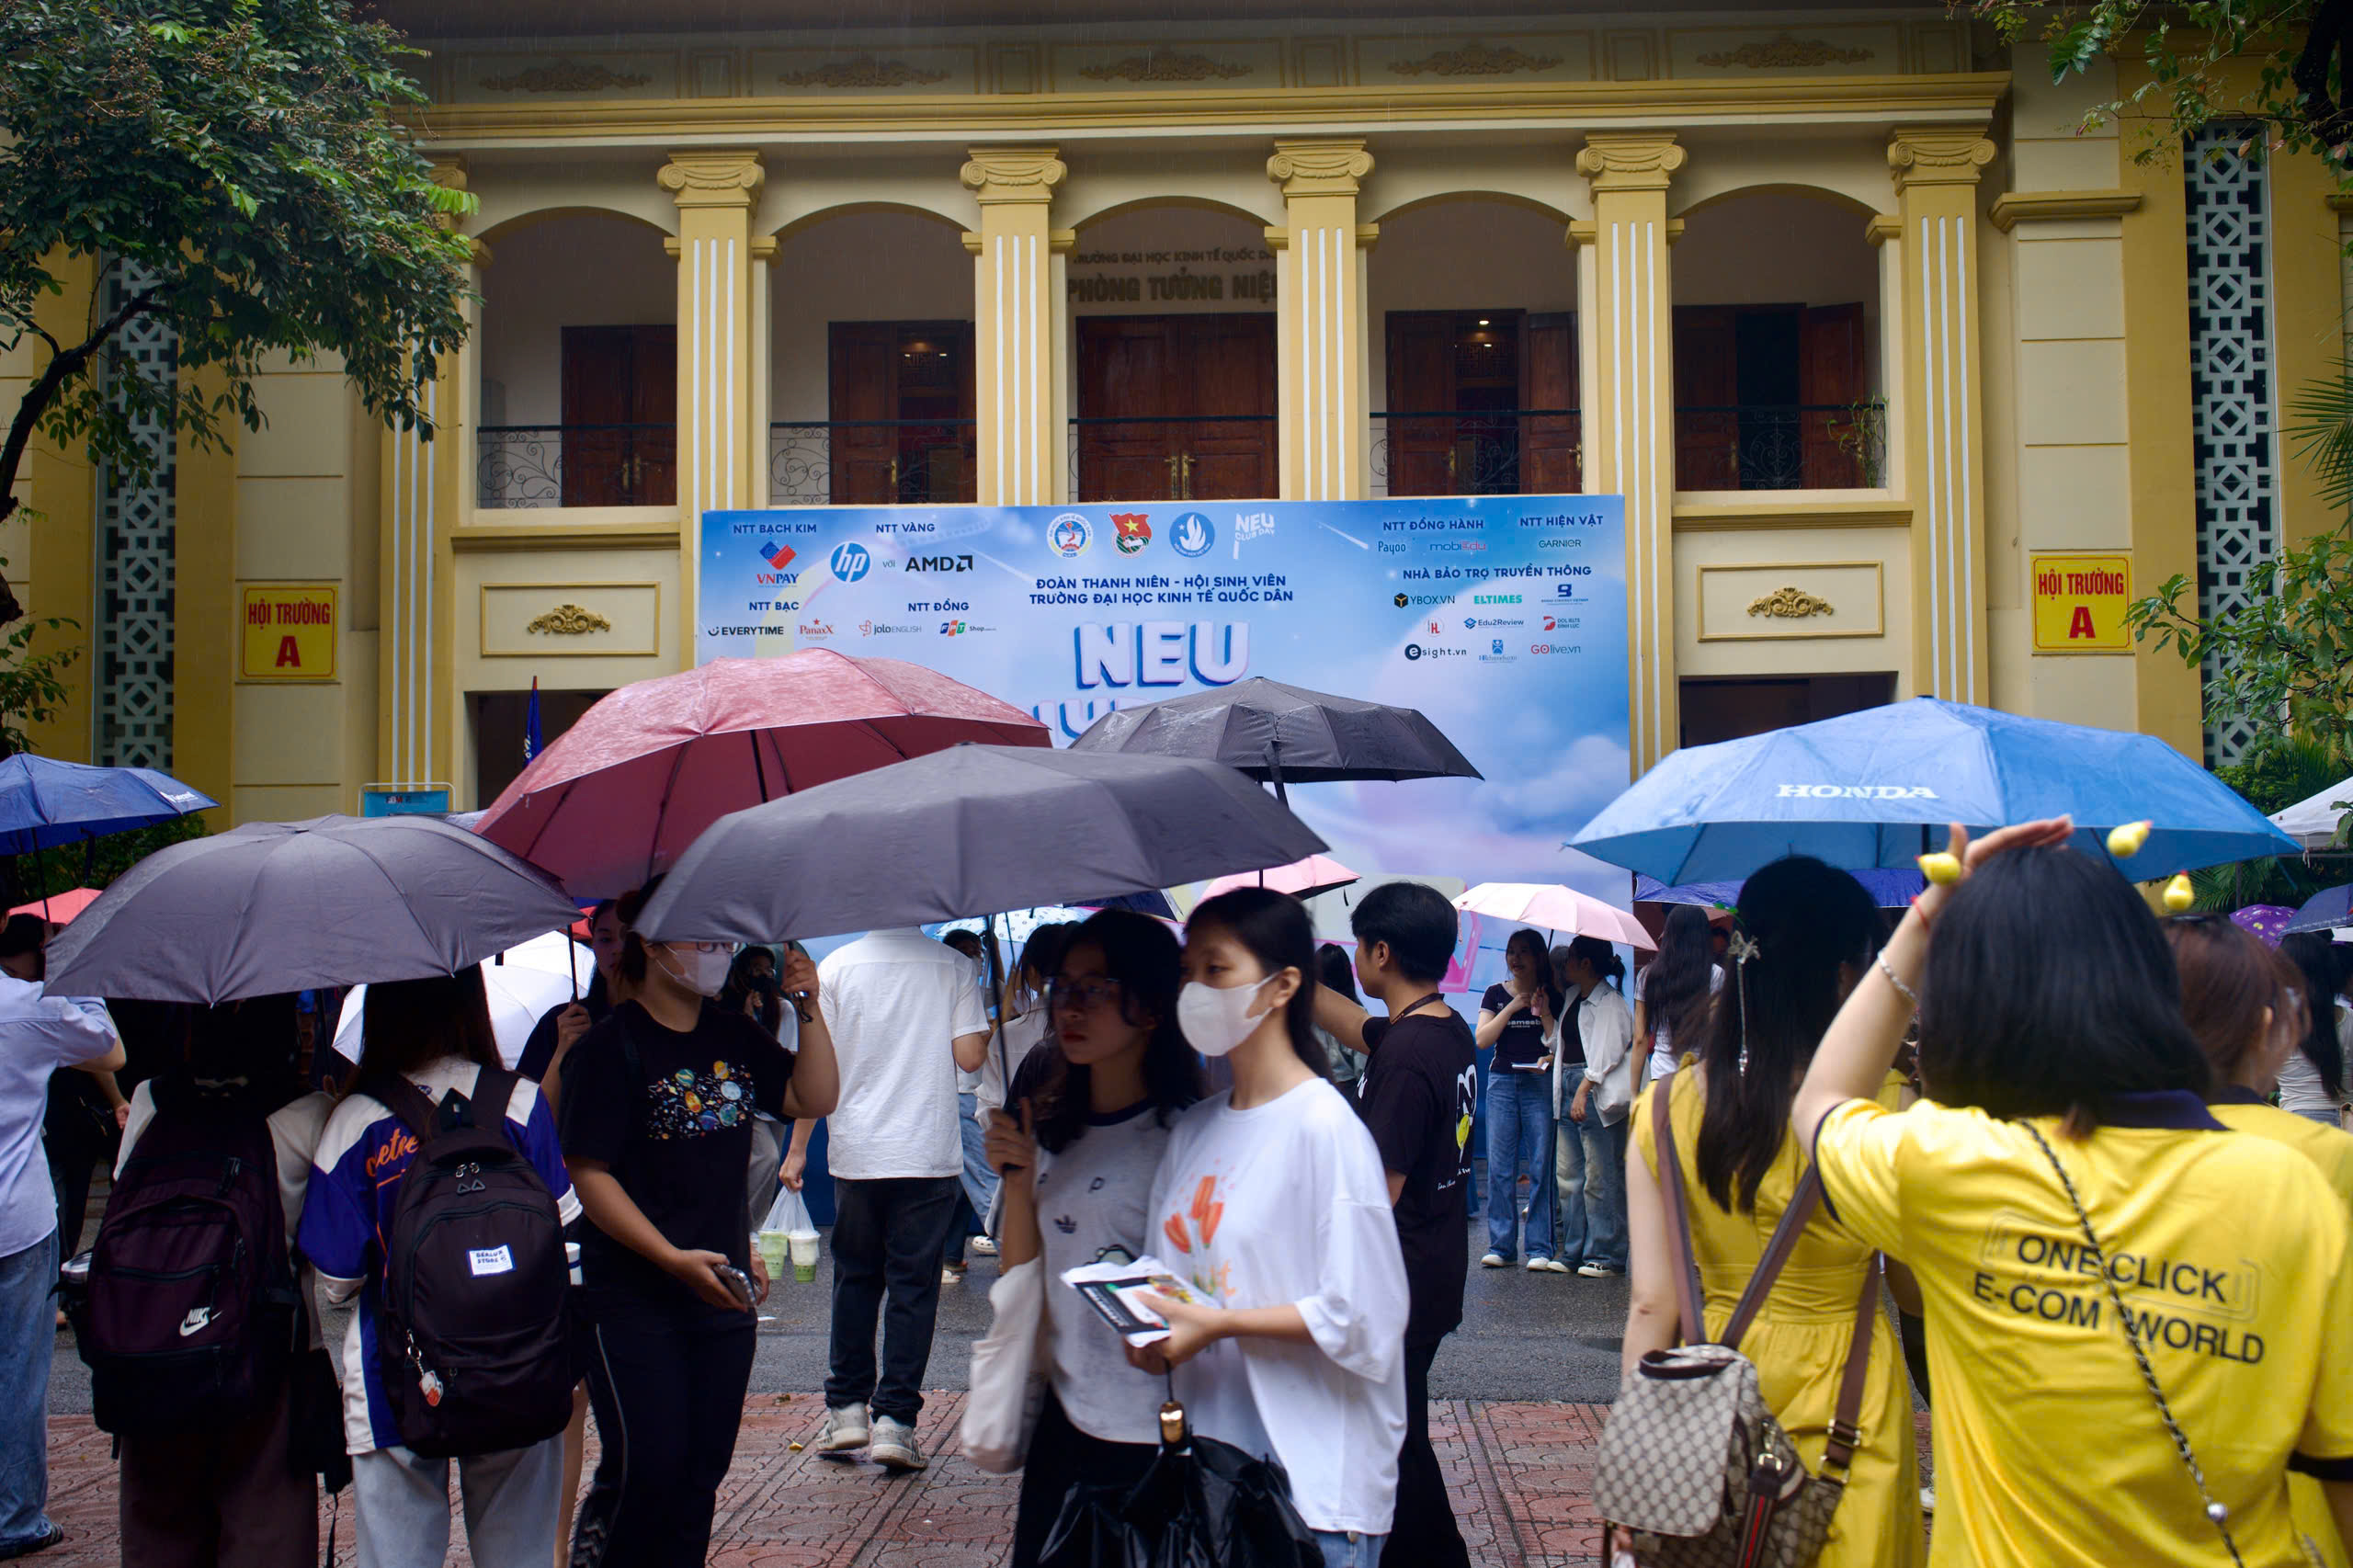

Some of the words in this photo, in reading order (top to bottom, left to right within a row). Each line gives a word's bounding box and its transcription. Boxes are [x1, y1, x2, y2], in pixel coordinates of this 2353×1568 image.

[1146, 251, 1170, 266] HỌC
[1174, 250, 1204, 263] KINH
[1206, 246, 1221, 262] TẾ
[1222, 247, 1256, 263] QUỐC
[1067, 273, 1141, 302] PHÒNG
[876, 524, 898, 533] NTT
[902, 522, 935, 532] VÀNG
[1234, 513, 1275, 533] NEU
[1383, 521, 1405, 530] NTT
[1409, 517, 1445, 530] ĐỒNG
[1449, 517, 1483, 529] HÀNH
[1520, 517, 1542, 527] NTT
[1546, 515, 1574, 528] HIỆN
[1579, 514, 1604, 527] VẬT
[733, 524, 756, 534] NTT
[759, 524, 791, 535] BẠCH
[796, 524, 817, 533] KIM
[1234, 530, 1257, 541] CLUB
[1378, 540, 1406, 555] Payoo
[1429, 540, 1486, 551] mobiEdu
[834, 541, 864, 583] hp
[905, 556, 954, 572] AMD
[1403, 567, 1430, 579] NHÀ
[1435, 566, 1461, 579] BẢO
[1464, 568, 1489, 580] TRỢ
[1494, 562, 1542, 577] TRUYỀN
[1547, 564, 1592, 576] THÔNG
[756, 574, 800, 585] VNPAY
[1036, 576, 1076, 589] ĐOÀN
[1082, 578, 1131, 588] THANH
[1135, 574, 1169, 587] NIÊN
[1184, 574, 1209, 589] HỘI
[1214, 576, 1247, 586] SINH
[1252, 574, 1286, 586] VIÊN
[2038, 568, 2063, 601] HỘI
[2066, 567, 2124, 596] TRƯỜNG
[908, 602, 930, 611] NTT
[933, 597, 970, 611] ĐỒNG
[1029, 591, 1088, 605] TRƯỜNG
[1093, 594, 1118, 606] ĐẠI
[1122, 593, 1153, 606] HỌC
[1157, 593, 1192, 603] KINH
[1197, 587, 1215, 602] TẾ
[1218, 587, 1259, 602] QUỐC
[1264, 588, 1293, 601] DÂN
[1410, 595, 1455, 605] YBOX.VN
[1473, 595, 1523, 605] ELTIMES
[248, 597, 271, 630] HỘI
[276, 597, 331, 626] TRƯỜNG
[749, 602, 771, 610] NTT
[775, 602, 800, 613] BẠC
[800, 625, 835, 635] PanaxX
[940, 622, 965, 634] FPT
[2068, 606, 2096, 639] A
[722, 626, 784, 636] EVERYTIME
[275, 635, 301, 667] A
[1074, 620, 1250, 689] NEU
[1775, 784, 1940, 799] HONDA
[2017, 1235, 2102, 1278] ONE
[2109, 1252, 2230, 1303] CLICK
[1973, 1271, 2102, 1329] E-COM
[2126, 1306, 2265, 1365] WORLD
